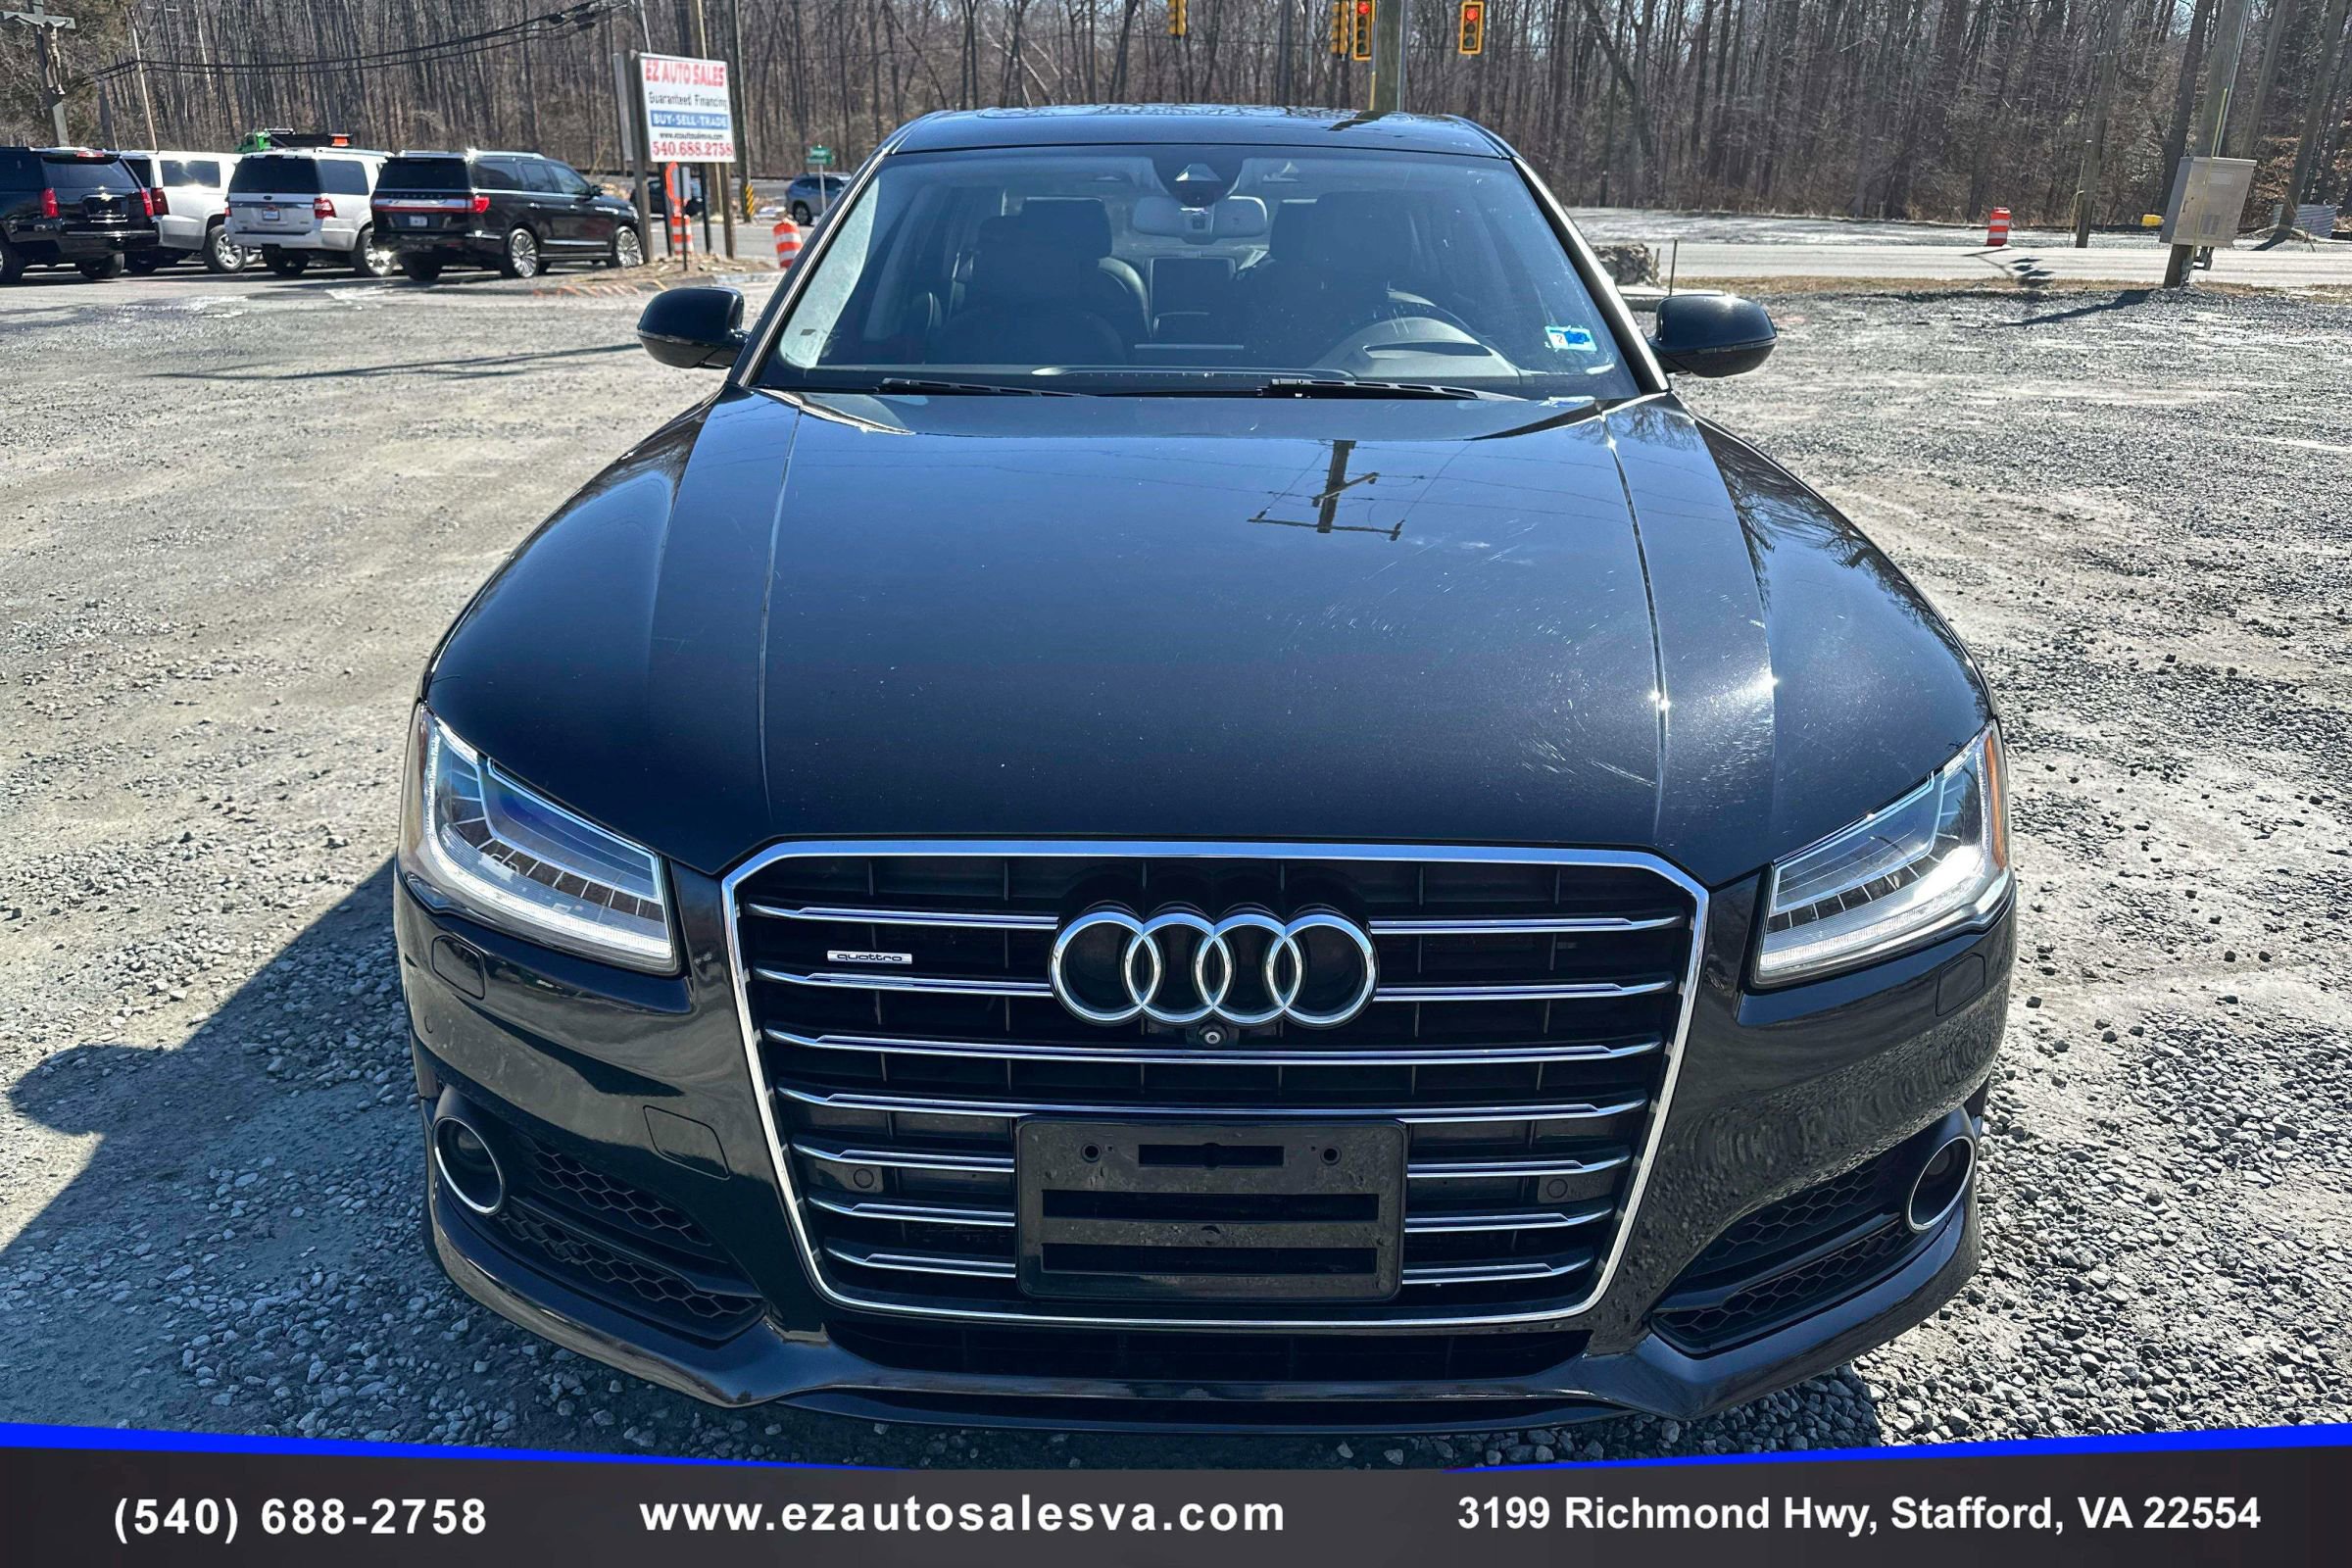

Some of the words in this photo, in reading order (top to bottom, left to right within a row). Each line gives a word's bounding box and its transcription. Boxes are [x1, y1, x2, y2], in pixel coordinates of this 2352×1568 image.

[645, 58, 660, 82] EZ
[662, 61, 691, 85] AUTO
[693, 63, 724, 87] SALES
[649, 91, 692, 106] Guaranteed
[694, 94, 728, 111] Financing
